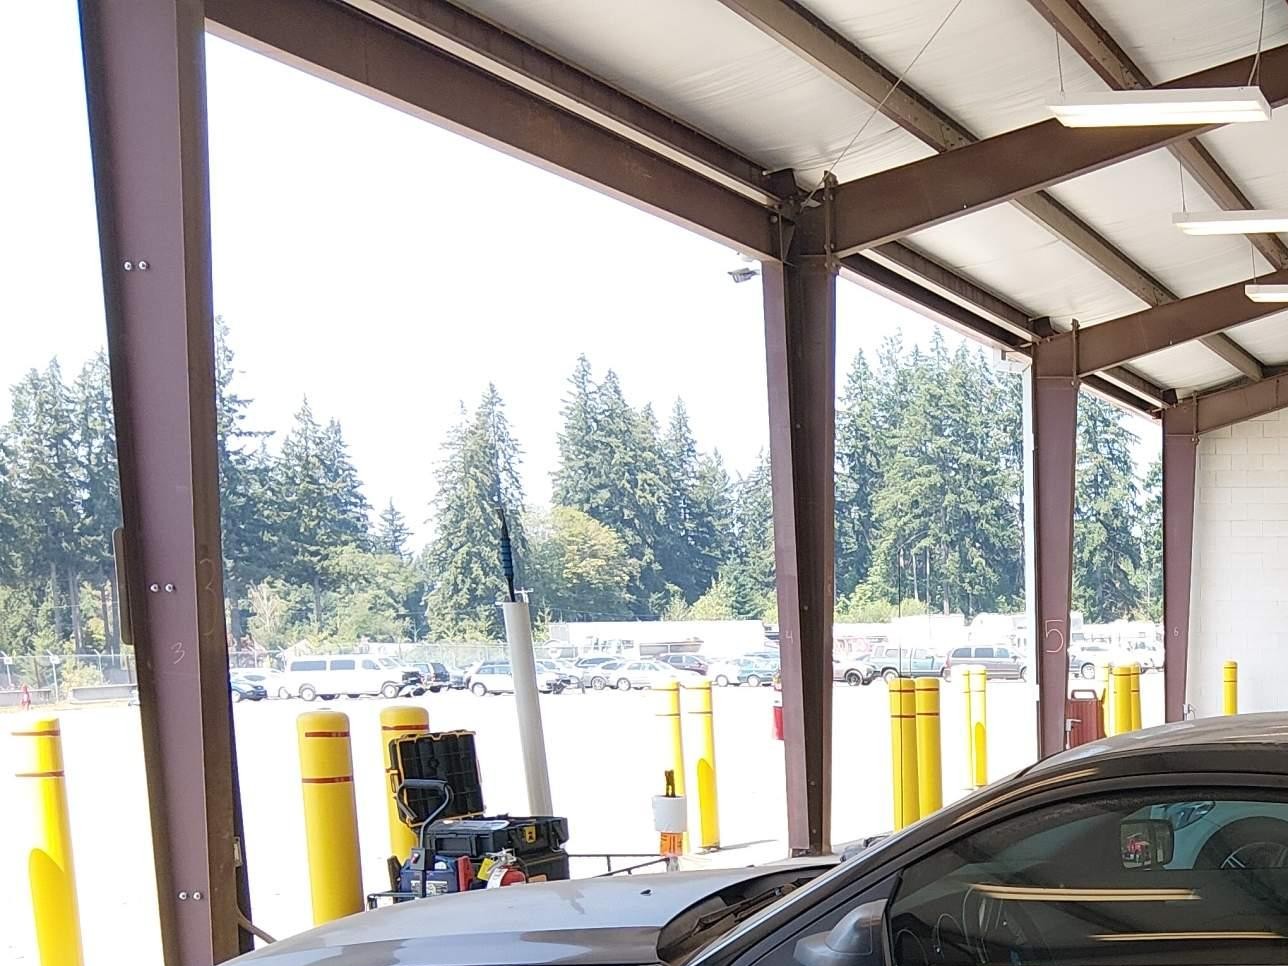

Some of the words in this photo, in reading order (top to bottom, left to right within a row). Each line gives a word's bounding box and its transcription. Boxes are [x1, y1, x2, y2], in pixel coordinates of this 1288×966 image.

[785, 630, 794, 644] 4
[1045, 619, 1065, 653] 5
[170, 641, 186, 665] 3
